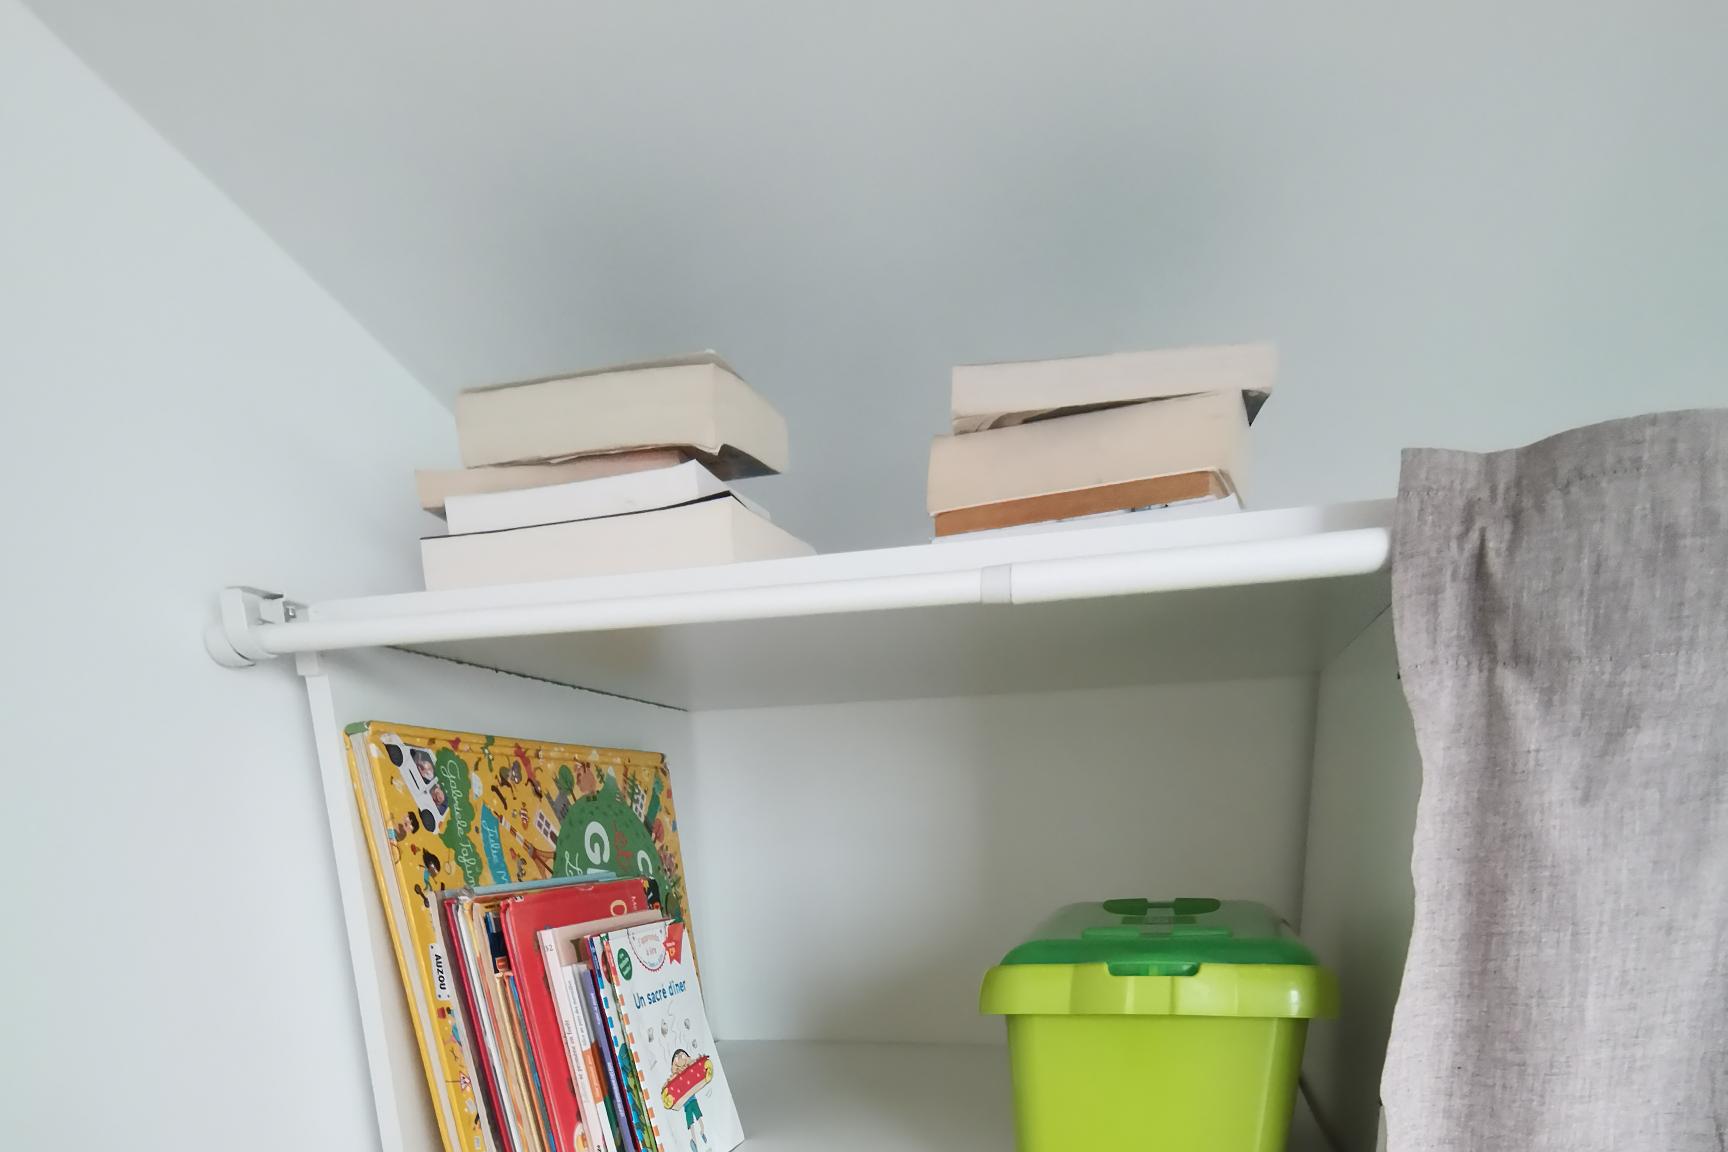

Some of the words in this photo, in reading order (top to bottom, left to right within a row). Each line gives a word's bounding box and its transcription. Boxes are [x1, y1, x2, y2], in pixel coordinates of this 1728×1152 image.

[434, 953, 447, 990] AUZOU
[633, 992, 647, 1009] Un
[646, 984, 667, 1005] sacré
